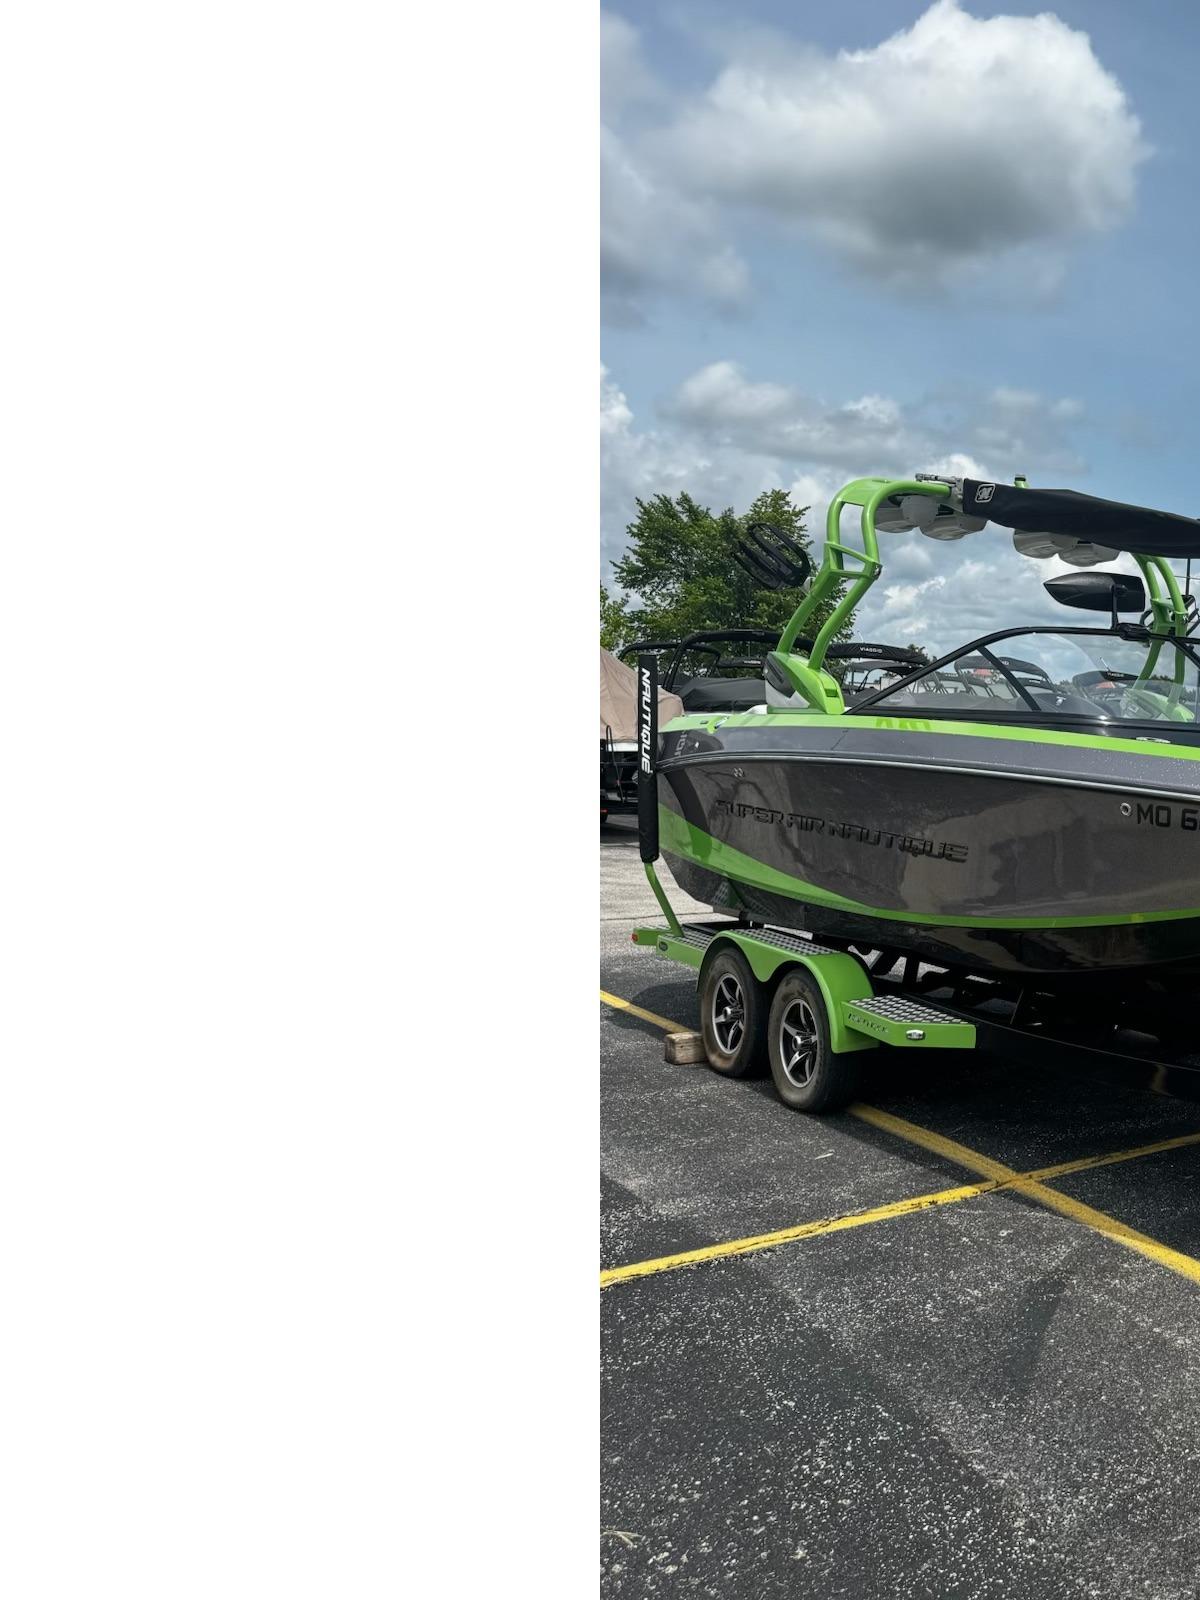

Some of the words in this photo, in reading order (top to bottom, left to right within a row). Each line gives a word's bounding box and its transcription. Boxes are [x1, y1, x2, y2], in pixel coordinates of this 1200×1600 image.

[641, 667, 653, 774] NAUTIQUE
[715, 799, 784, 825] SUPER
[786, 813, 825, 833] AIR
[828, 820, 968, 863] NAUTIQUE
[1137, 803, 1171, 828] MO
